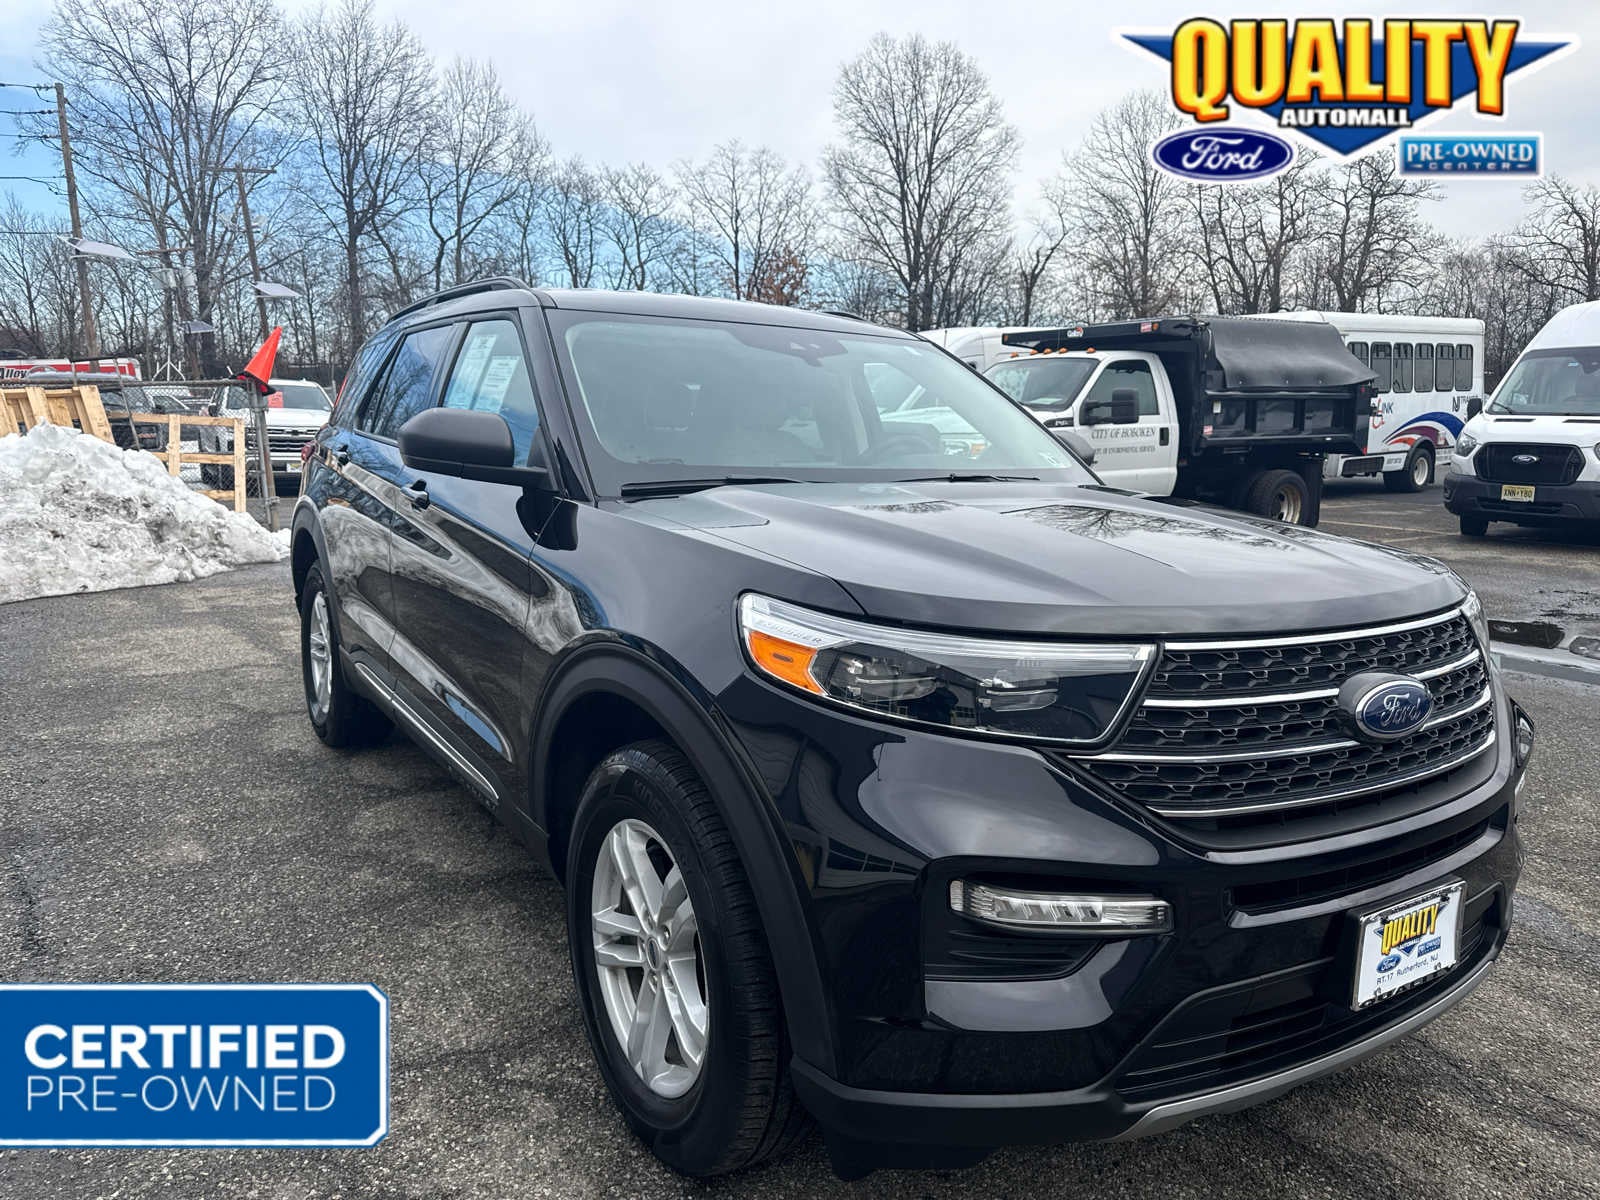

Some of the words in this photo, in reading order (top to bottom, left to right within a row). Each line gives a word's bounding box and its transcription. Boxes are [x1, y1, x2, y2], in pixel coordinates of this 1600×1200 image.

[1091, 428, 1109, 439] CITY
[1110, 428, 1120, 439] OF
[1121, 427, 1155, 438] HOBOKEN
[1381, 692, 1420, 727] Ford
[1381, 903, 1440, 956] QUALITY
[1431, 953, 1439, 963] NJ
